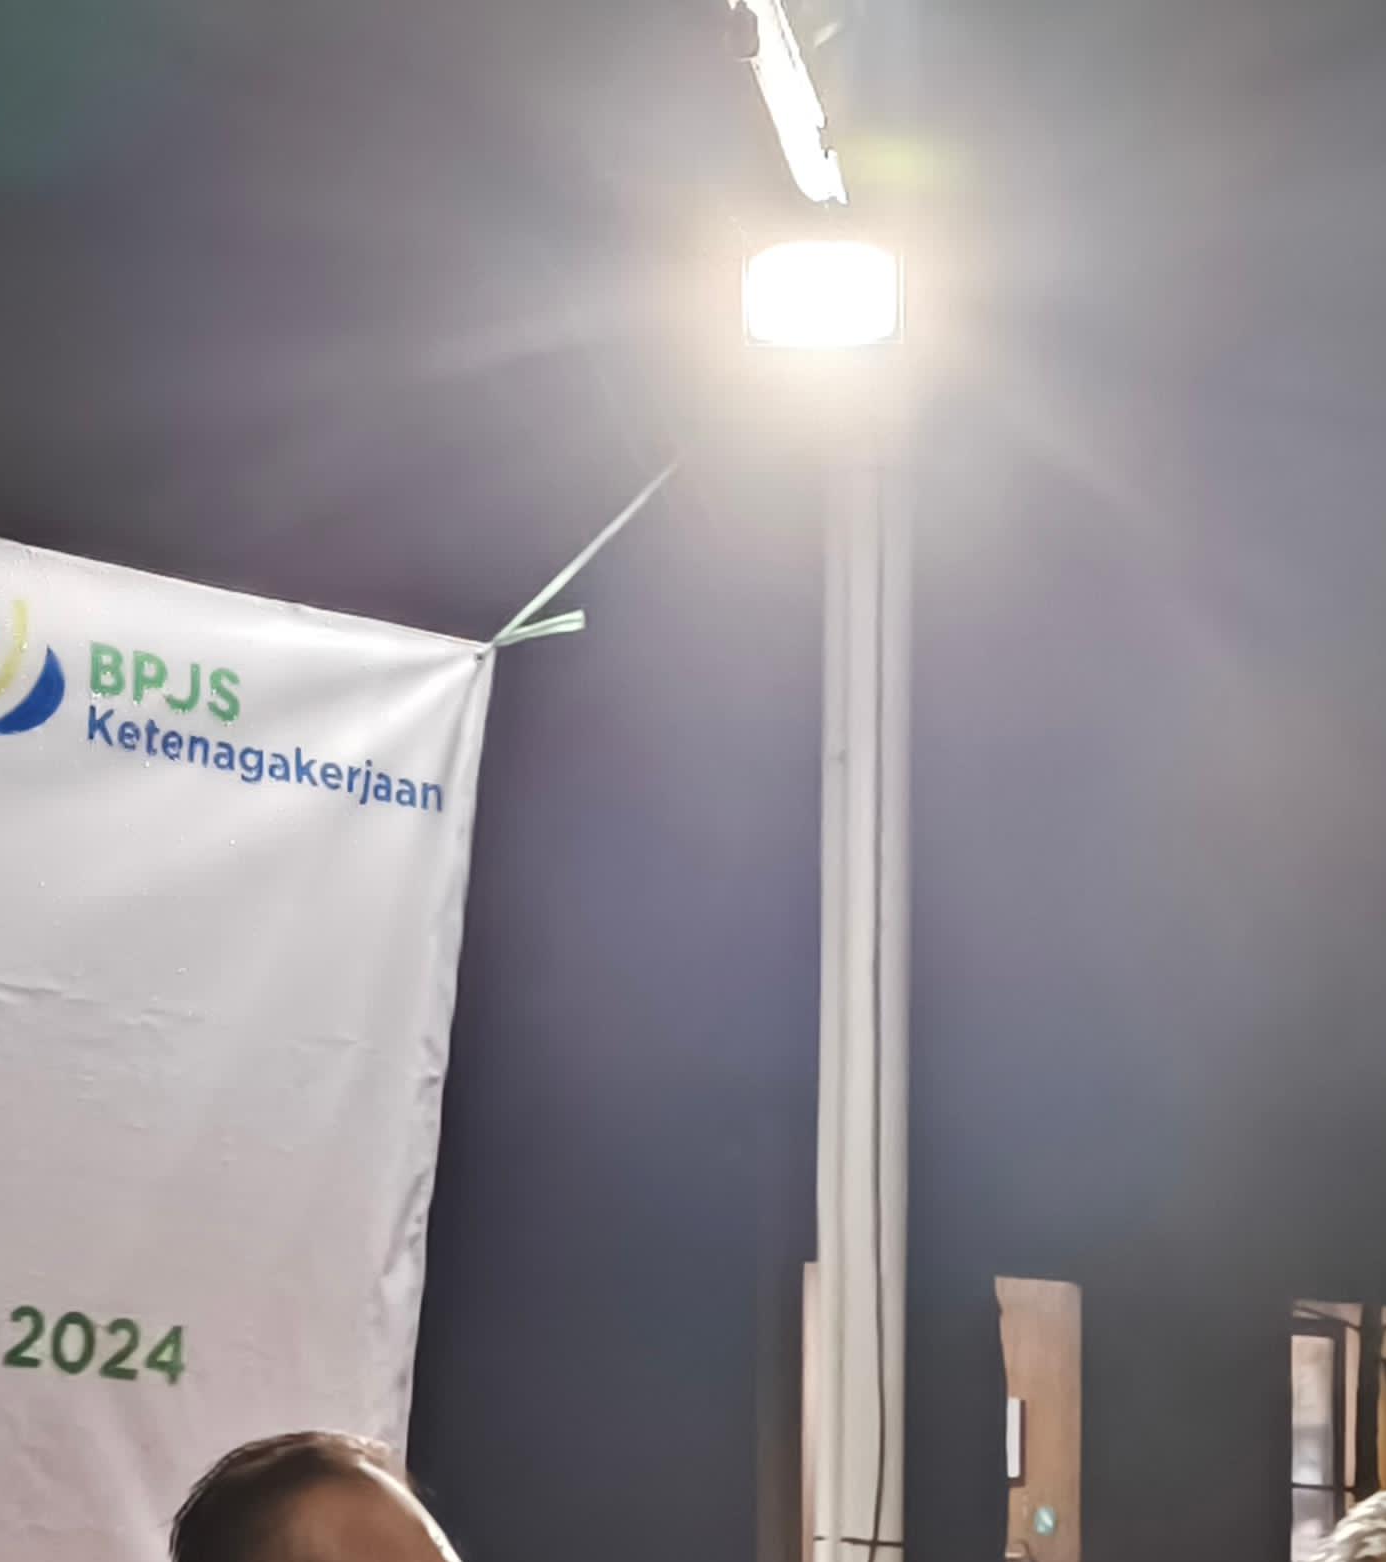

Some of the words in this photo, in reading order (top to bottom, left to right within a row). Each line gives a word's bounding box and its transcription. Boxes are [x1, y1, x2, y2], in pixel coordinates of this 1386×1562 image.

[88, 639, 241, 725] BPJS
[87, 704, 445, 813] Ketenagakerjaan
[2, 1304, 187, 1386] 2024
